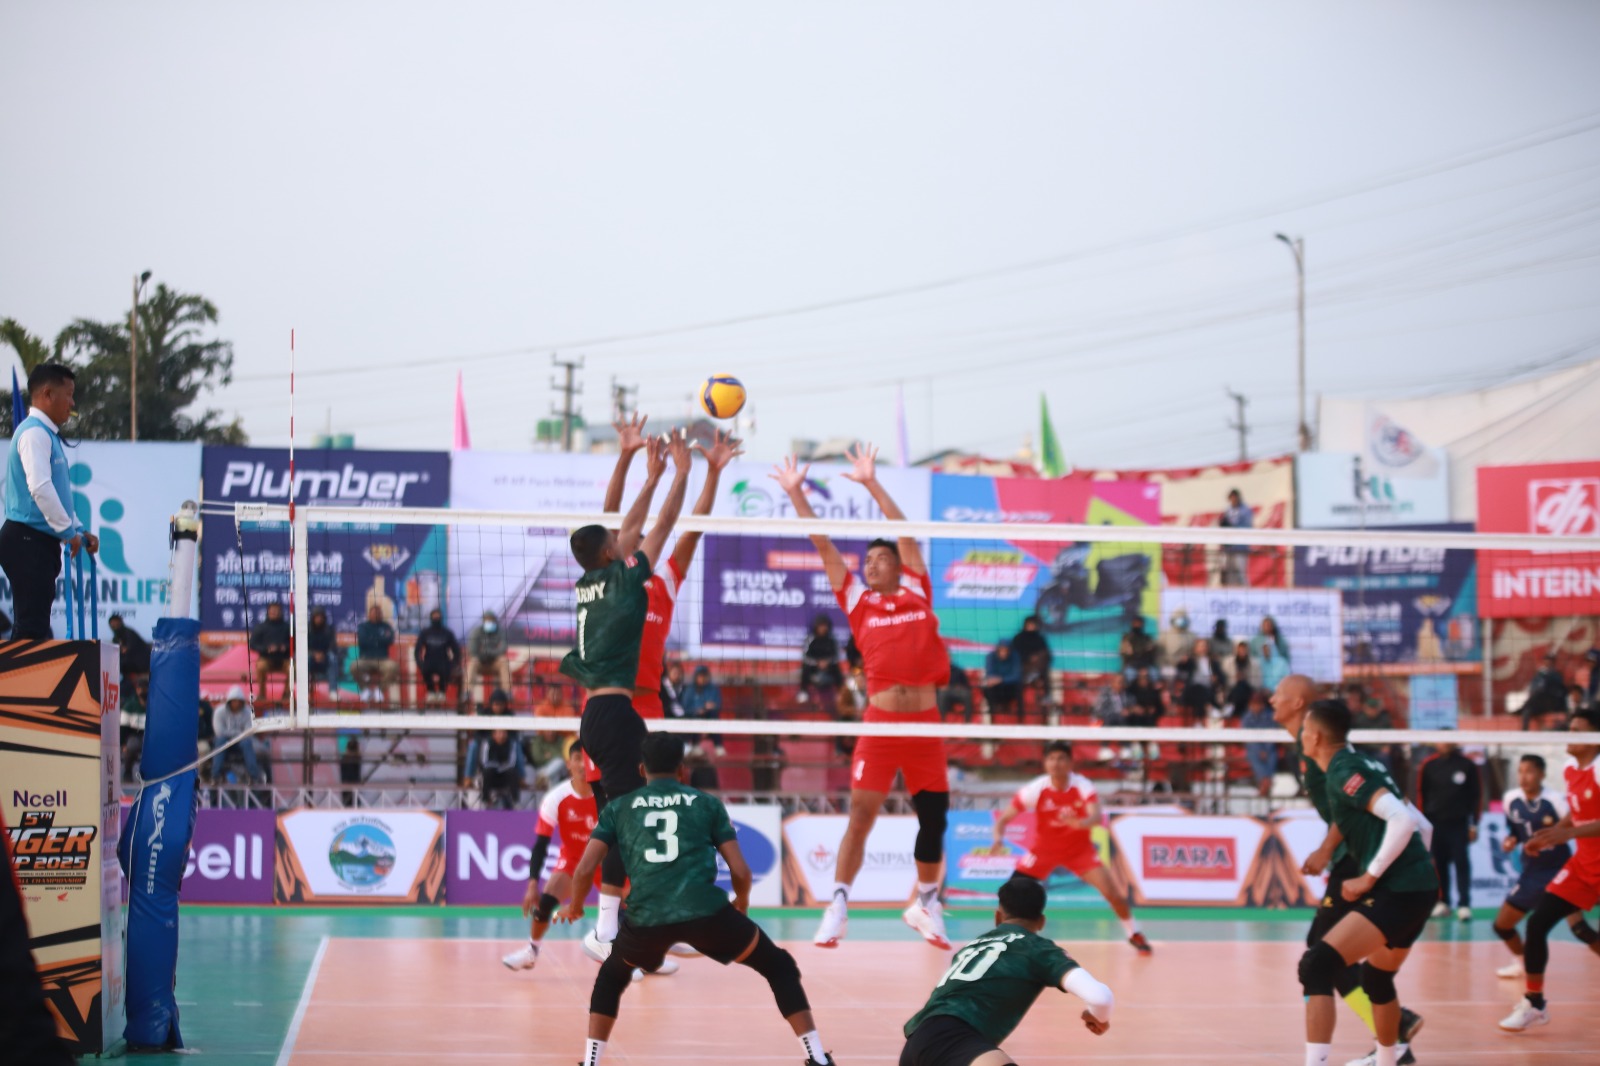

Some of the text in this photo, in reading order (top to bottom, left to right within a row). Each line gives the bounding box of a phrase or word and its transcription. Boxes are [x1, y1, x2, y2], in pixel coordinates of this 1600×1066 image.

[221, 461, 420, 500] Plumber
[722, 571, 786, 589] STUDY
[575, 581, 606, 603] ARMY
[722, 590, 805, 606] ABROAD
[13, 790, 67, 807] Ncell
[631, 793, 698, 809] ARMY
[644, 810, 679, 863] 3
[33, 856, 87, 870] 2025
[183, 833, 263, 880] ell
[457, 832, 560, 881] Nce
[1148, 845, 1232, 868] RARA
